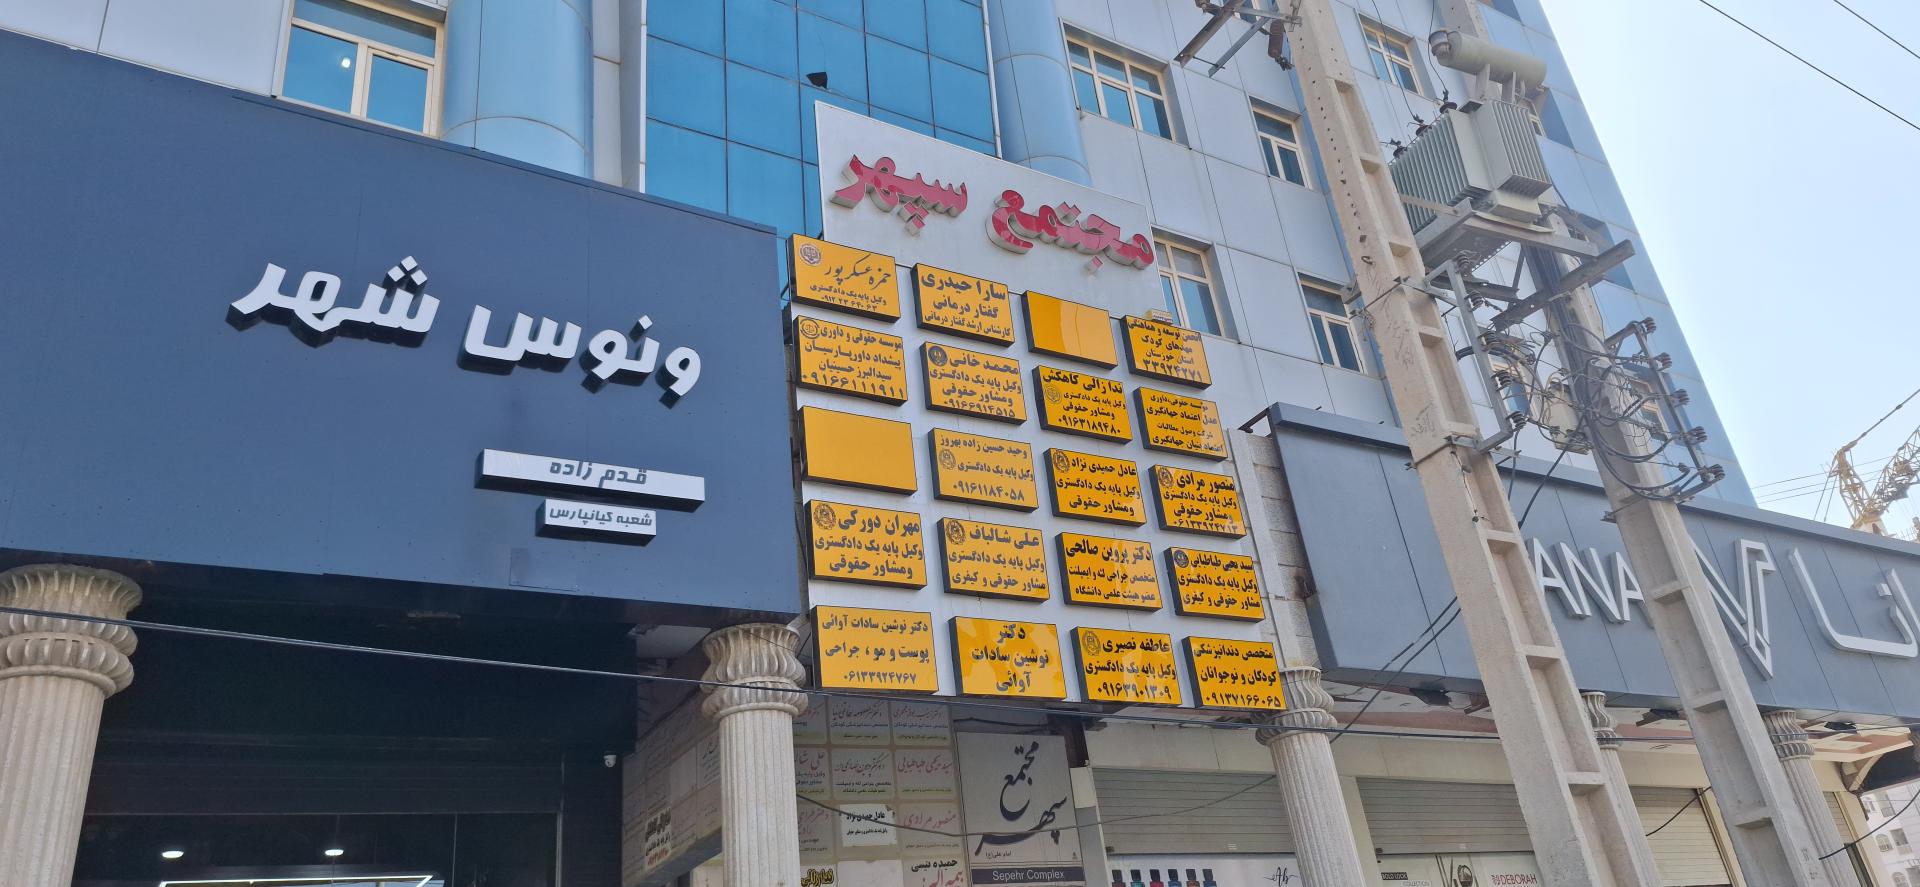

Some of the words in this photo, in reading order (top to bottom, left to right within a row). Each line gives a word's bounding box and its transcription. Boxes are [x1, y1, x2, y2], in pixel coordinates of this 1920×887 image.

[831, 154, 968, 234] سپهر
[987, 190, 1154, 271] مجتمع
[810, 285, 845, 295] دادگستری
[921, 273, 972, 294] حیدری
[228, 255, 441, 340] شهر
[976, 280, 1006, 302] سارا
[933, 294, 970, 315] درمانی
[973, 303, 998, 318] گفتار
[925, 311, 948, 324] درمانی
[950, 315, 965, 326] گفتار
[821, 326, 844, 339] داوری
[966, 320, 982, 333] ارشد
[983, 324, 1010, 338] کارشناس
[846, 333, 851, 342] و
[852, 333, 876, 346] حقوقی
[1141, 335, 1162, 348] کودک
[462, 314, 702, 402] ونوس
[950, 352, 980, 367] خانی
[1146, 349, 1174, 361] خوزستان
[819, 359, 854, 373] حسینیان
[983, 360, 1020, 374] محمد
[930, 368, 969, 380] دادگستری
[972, 375, 984, 387] یک
[802, 371, 904, 399] ۰۹۱۶۶۱۱۱۹۱۱
[942, 382, 977, 398] حقوقی
[987, 377, 1000, 391] پایه
[1002, 380, 1021, 394] وکیل
[1063, 392, 1090, 401] دادگستری
[1062, 402, 1088, 413] حقوقی
[1113, 400, 1126, 410] وکیل
[963, 438, 981, 451] زاده
[983, 444, 1004, 453] حسین
[1007, 445, 1027, 459] وحید
[550, 461, 592, 480] زاده
[957, 461, 991, 472] دادگستری
[992, 465, 1003, 477] یک
[1071, 457, 1087, 471] نژاد
[1089, 464, 1115, 474] حمیدی
[1117, 464, 1136, 477] عادل
[598, 468, 647, 488] قدم
[1005, 467, 1016, 479] پایه
[1018, 469, 1035, 481] وکیل
[1057, 478, 1092, 489] دادگستری
[1095, 482, 1106, 494] یک
[1177, 472, 1205, 491] مرادی
[1209, 480, 1234, 493] منصور
[1109, 484, 1121, 497] پایه
[1123, 485, 1140, 499] وکیل
[1164, 489, 1195, 500] دادگستری
[1069, 495, 1101, 510] حقوقی
[1196, 494, 1207, 505] یک
[1209, 495, 1220, 507] پایه
[1222, 497, 1237, 509] وکیل
[549, 508, 613, 525] کیانپارس
[1174, 503, 1202, 518] حقوقی
[616, 513, 652, 527] شعبه
[838, 509, 881, 533] دورکی
[885, 514, 919, 537] مهران
[969, 525, 1011, 545] شالباف
[1014, 533, 1039, 549] علی
[815, 536, 862, 550] دادگستری
[865, 539, 880, 555] یک
[882, 541, 899, 558] پایه
[1066, 539, 1099, 557] صالحی
[902, 543, 923, 560] وکیل
[949, 551, 990, 563] دادگستری
[1102, 547, 1128, 564] پروین
[1131, 546, 1151, 564] دکتر
[829, 554, 870, 573] حقوقی
[992, 554, 1006, 568] یک
[1008, 556, 1023, 570] پایه
[1025, 557, 1044, 572] وکیل
[1240, 561, 1253, 573] سید
[952, 570, 978, 584] کیفری
[982, 577, 987, 586] و
[990, 573, 1018, 589] حقوقی
[1107, 570, 1128, 583] جراحی
[1130, 572, 1155, 584] متخصص
[1178, 574, 1212, 586] دادگستری
[1214, 576, 1225, 590] یک
[1022, 578, 1045, 591] مشاور
[1075, 586, 1101, 596] دانشگاه
[1227, 577, 1239, 592] پایه
[1241, 578, 1258, 593] وکیل
[1104, 589, 1120, 599] علمی
[1141, 591, 1155, 602] عضو
[1183, 591, 1204, 604] کیفری
[1214, 593, 1237, 608] حقوقی
[1241, 597, 1260, 610] مشاور
[851, 617, 879, 629] سادات
[882, 619, 907, 634] نوشین
[910, 621, 928, 634] دکتر
[996, 623, 1026, 643] دکتر
[825, 642, 860, 659] جراحی
[1102, 637, 1136, 653] نصیری
[1140, 638, 1170, 652] عاطفه
[890, 648, 896, 661] و
[899, 646, 929, 664] پوست
[972, 645, 1010, 661] سادات
[1014, 649, 1048, 668] نوشین
[1242, 647, 1273, 660] متخصص
[1085, 660, 1124, 675] دادگستری
[1126, 662, 1139, 677] یک
[1141, 662, 1155, 679] پایه
[1158, 664, 1176, 680] وکیل
[1200, 665, 1238, 684] نوجوانان
[844, 671, 916, 684] ۰۶۱۳۳۹۲۴۷۶۷
[1241, 674, 1246, 685] و
[1248, 669, 1276, 686] کودکان
[1206, 692, 1281, 707] ۰۹۱۳۷۱۶۶۰۶۵
[1000, 741, 1039, 821] مجتمع
[975, 796, 1067, 857] سپهر
[992, 870, 1024, 882] Sepehr
[1026, 869, 1065, 880] Complex
[1499, 874, 1537, 885] DEBORAH
